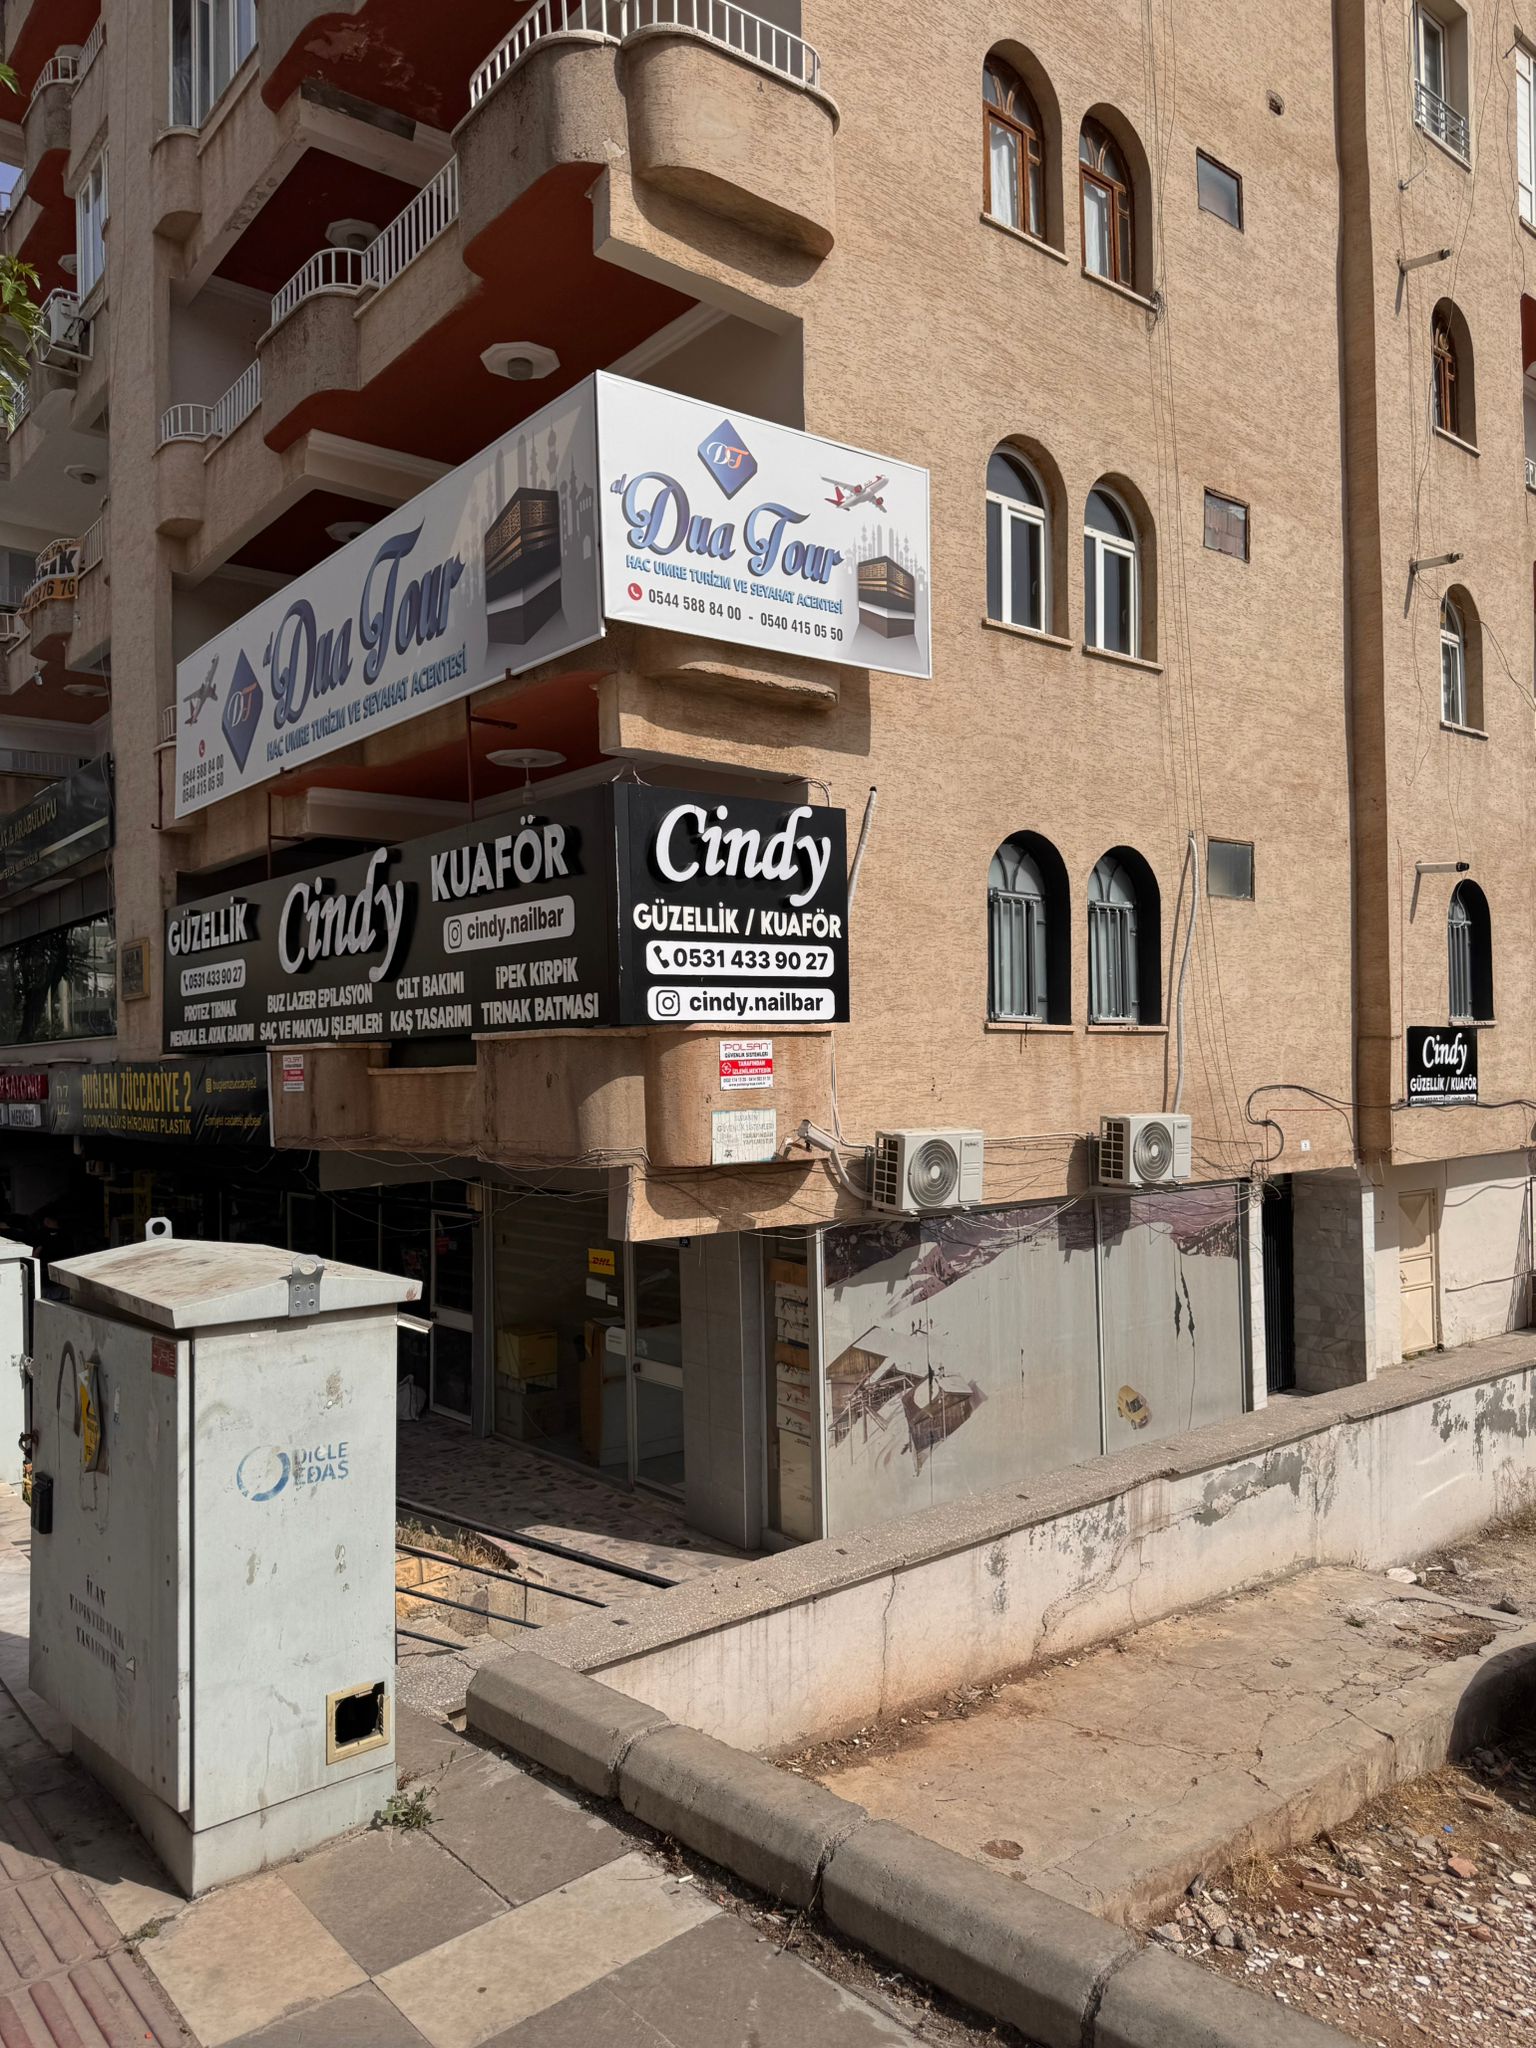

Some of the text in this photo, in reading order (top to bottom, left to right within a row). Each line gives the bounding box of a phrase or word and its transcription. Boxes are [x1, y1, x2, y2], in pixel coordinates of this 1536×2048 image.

[743, 502, 845, 584] Tour
[359, 516, 466, 685] Tour
[626, 555, 843, 615] HAC UMRE TURİZM VE SEYAHAT ACENTESİ
[648, 588, 680, 609] 0544
[683, 595, 705, 613] 588
[709, 601, 724, 618] 84
[727, 605, 742, 621] 00
[760, 612, 788, 631] 0540
[791, 618, 811, 635] 415
[814, 624, 828, 639] 05
[830, 628, 843, 642] 50
[267, 641, 467, 762] HAC UMRE TURİZM VE SEYAHAT ACENTESİ
[182, 753, 224, 787] 0544 588 84 00
[182, 785, 195, 803] 0540
[197, 779, 207, 796] 415
[216, 771, 224, 788] 50
[430, 815, 569, 901] KUAFÖR
[656, 803, 831, 907] Cindy
[168, 896, 249, 956] GÜZELLİK
[278, 847, 404, 982] Cindy
[467, 907, 564, 945] cindy.nailbar
[633, 898, 842, 939] GÜZELLİK / KUAFÖR
[496, 957, 579, 990] İPEK KİRPİK
[673, 948, 829, 970] 0531 433 90 27
[188, 966, 242, 989] 0531 433 90 27
[396, 971, 464, 1000] CİLT BAKIMI
[184, 999, 237, 1022] PROTEZ TIRNAK
[267, 982, 373, 1013] BUZ LAZER EPİLASYON
[481, 992, 599, 1025] TIRNAK BATMASI
[689, 991, 824, 1016] cindy.nailbar
[199, 1027, 207, 1045] EL
[208, 1025, 226, 1044] AYAK
[228, 1023, 254, 1042] BAKIMI
[260, 1021, 277, 1043] SAÇ
[279, 1020, 290, 1039] VE
[292, 1017, 329, 1038] MAKYAJ
[390, 1003, 472, 1035] KAŞ TASARIMI
[724, 1043, 769, 1052] POLSAN
[1422, 1032, 1467, 1075] Cindy
[121, 1066, 180, 1112] ZÜCCACİYE
[183, 1071, 192, 1112] 2
[1410, 1074, 1445, 1092] GÜZELLİK
[1451, 1073, 1477, 1091] KUAFÖR
[160, 1116, 192, 1135] PLASTİK
[592, 1256, 611, 1266] DHL
